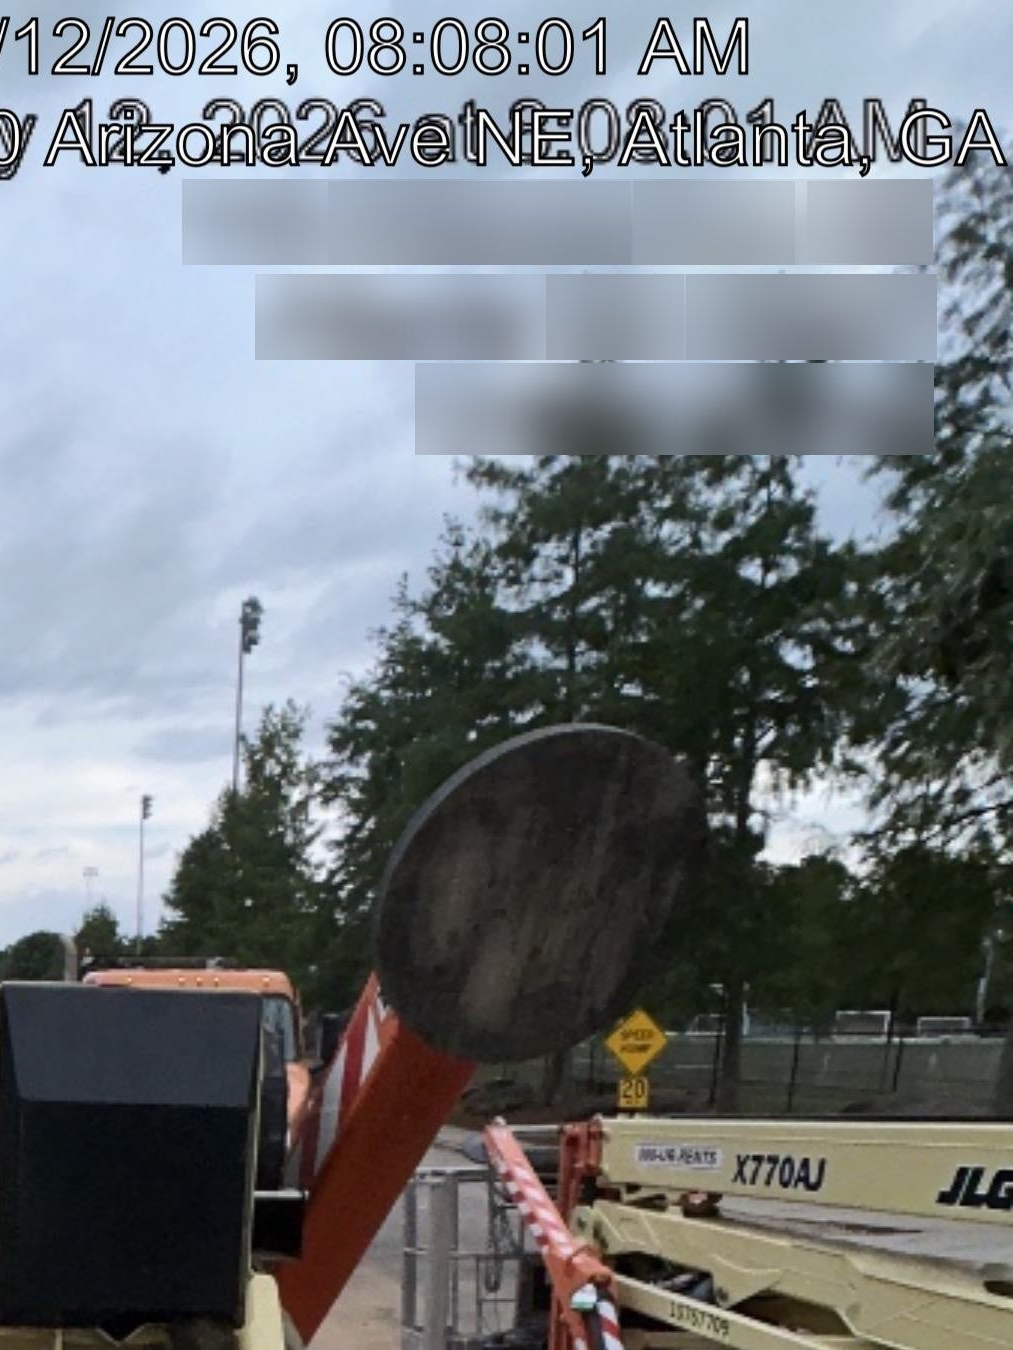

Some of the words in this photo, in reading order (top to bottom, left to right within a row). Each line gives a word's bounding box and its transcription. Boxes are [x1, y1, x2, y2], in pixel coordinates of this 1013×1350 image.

[621, 1079, 646, 1098] 20
[731, 1153, 827, 1191] X770AJ
[935, 1166, 1013, 1210] JLG
